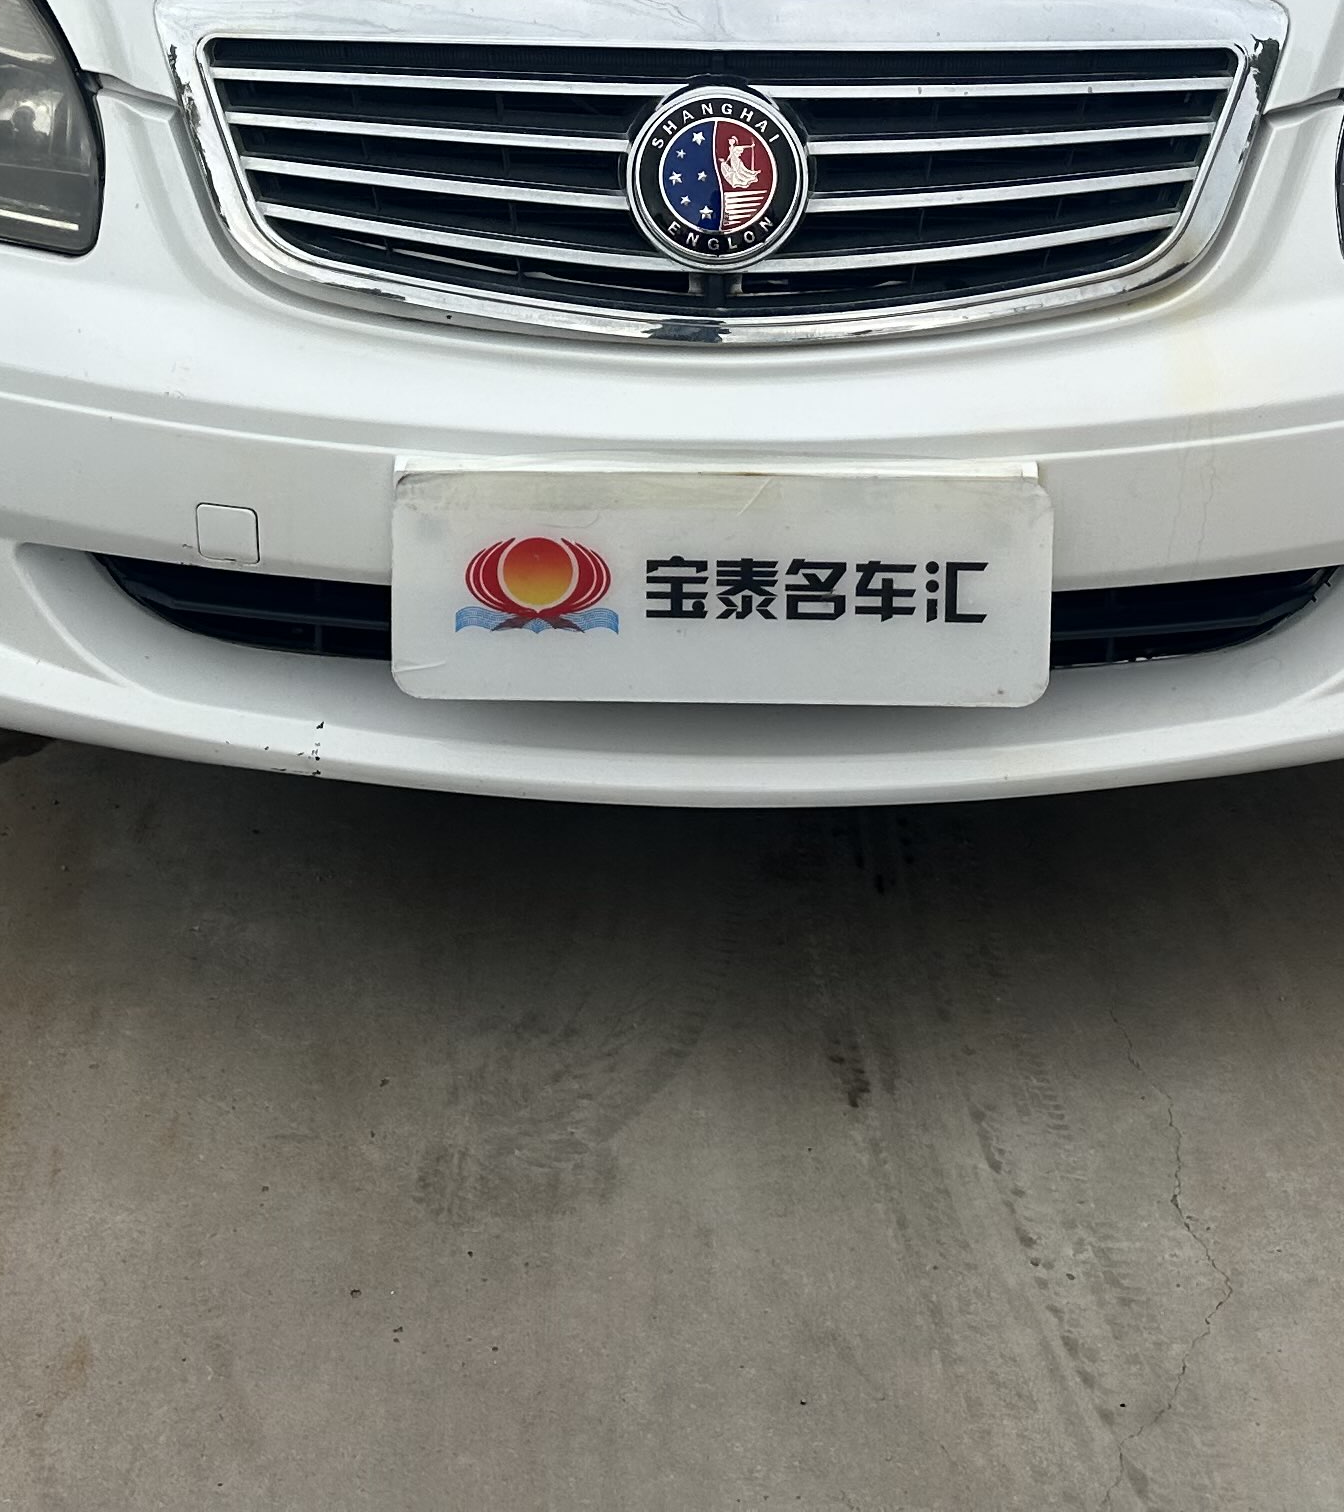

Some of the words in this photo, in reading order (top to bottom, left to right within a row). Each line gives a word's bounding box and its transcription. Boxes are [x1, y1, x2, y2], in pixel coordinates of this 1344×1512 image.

[652, 102, 780, 149] SHANGHAI
[667, 216, 774, 251] ENGLON
[646, 555, 989, 624] 宝泰名车汇
